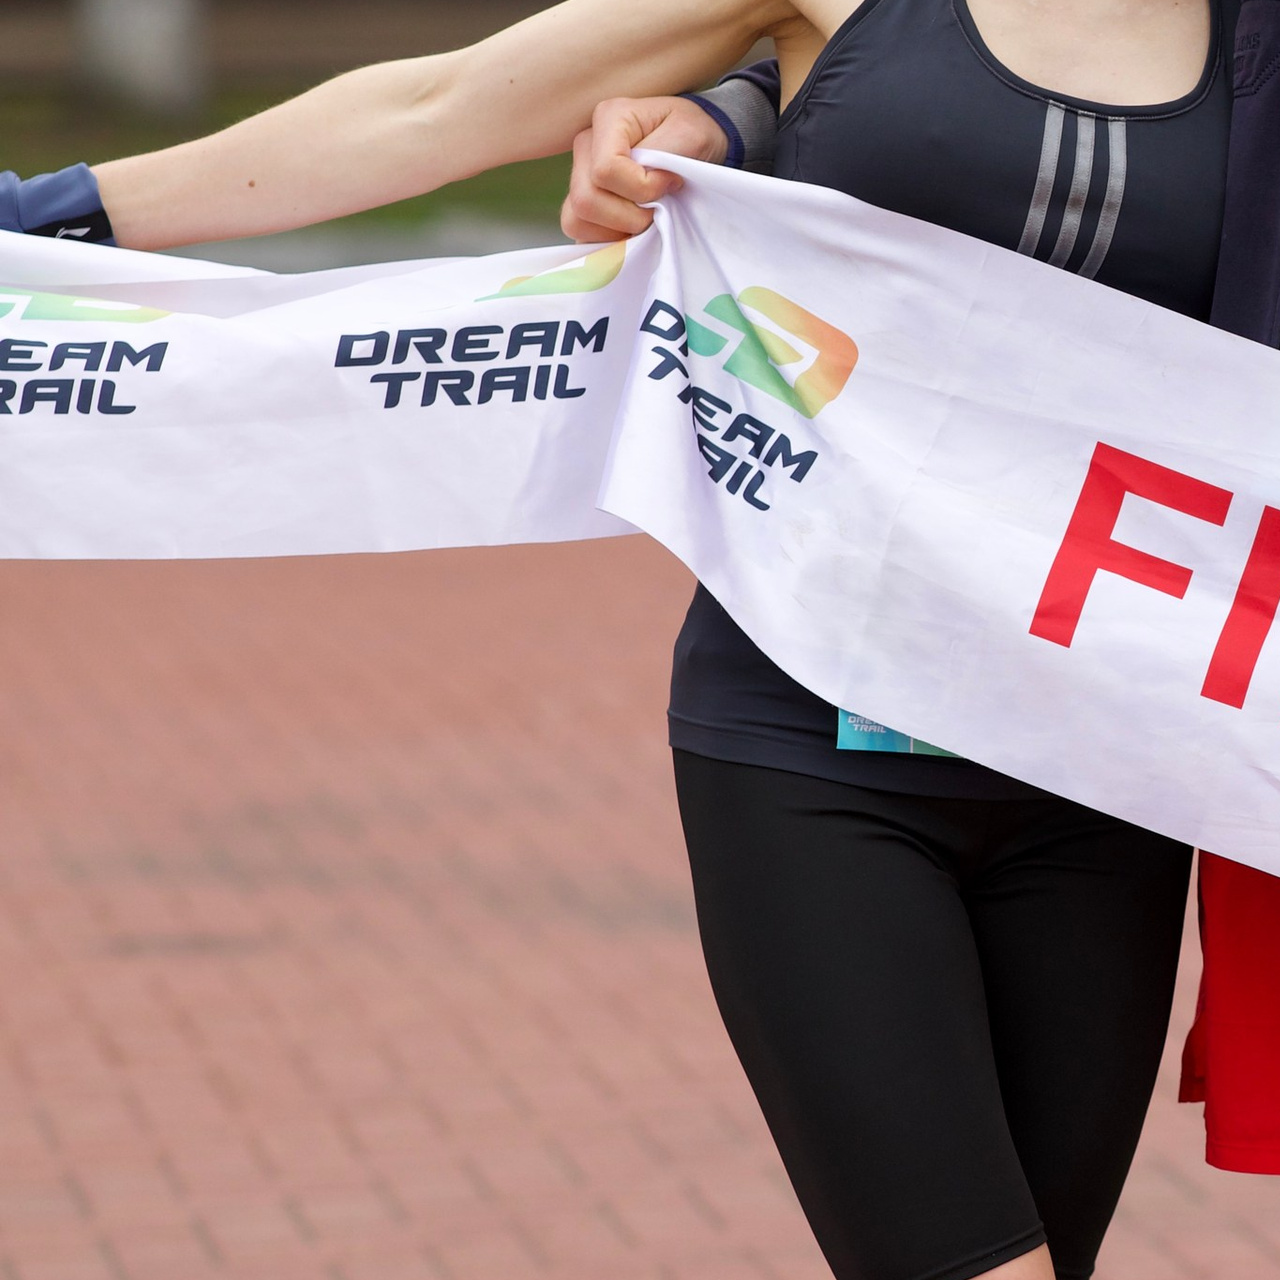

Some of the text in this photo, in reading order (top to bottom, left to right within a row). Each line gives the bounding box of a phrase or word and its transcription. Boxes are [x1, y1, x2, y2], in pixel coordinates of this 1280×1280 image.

[334, 316, 610, 367] DREAM
[370, 363, 587, 409] TRAIL
[853, 723, 887, 734] TRAIL
